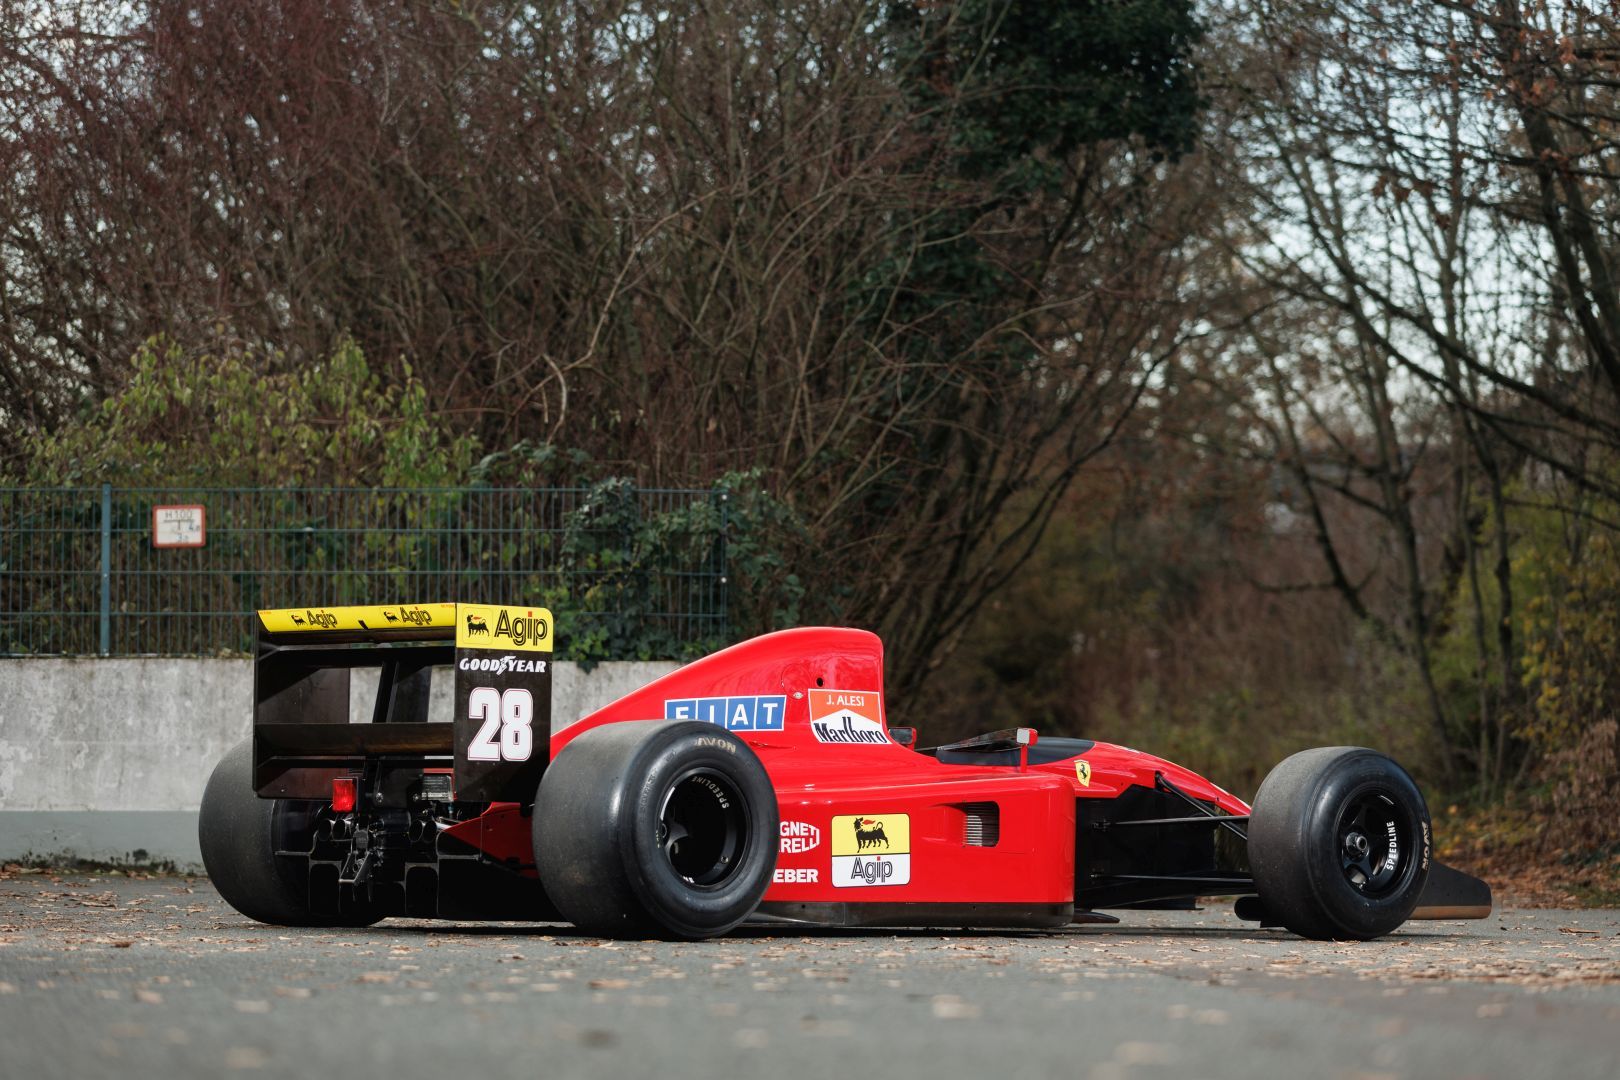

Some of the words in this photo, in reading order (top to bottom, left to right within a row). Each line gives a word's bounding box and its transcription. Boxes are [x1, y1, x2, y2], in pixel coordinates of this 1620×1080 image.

[306, 609, 338, 628] Agip
[399, 606, 432, 626] Agip
[494, 609, 548, 646] Agip
[459, 655, 547, 675] GOODYEAR
[826, 694, 835, 705] J.
[836, 695, 865, 707] ALESI
[467, 686, 533, 762] 28
[675, 703, 778, 726] FIAT
[813, 716, 888, 743] Marlboro
[695, 736, 737, 753] AVON
[779, 836, 820, 853] RELLI
[1386, 821, 1398, 871] SPEEDLINE
[850, 856, 893, 884] Agip
